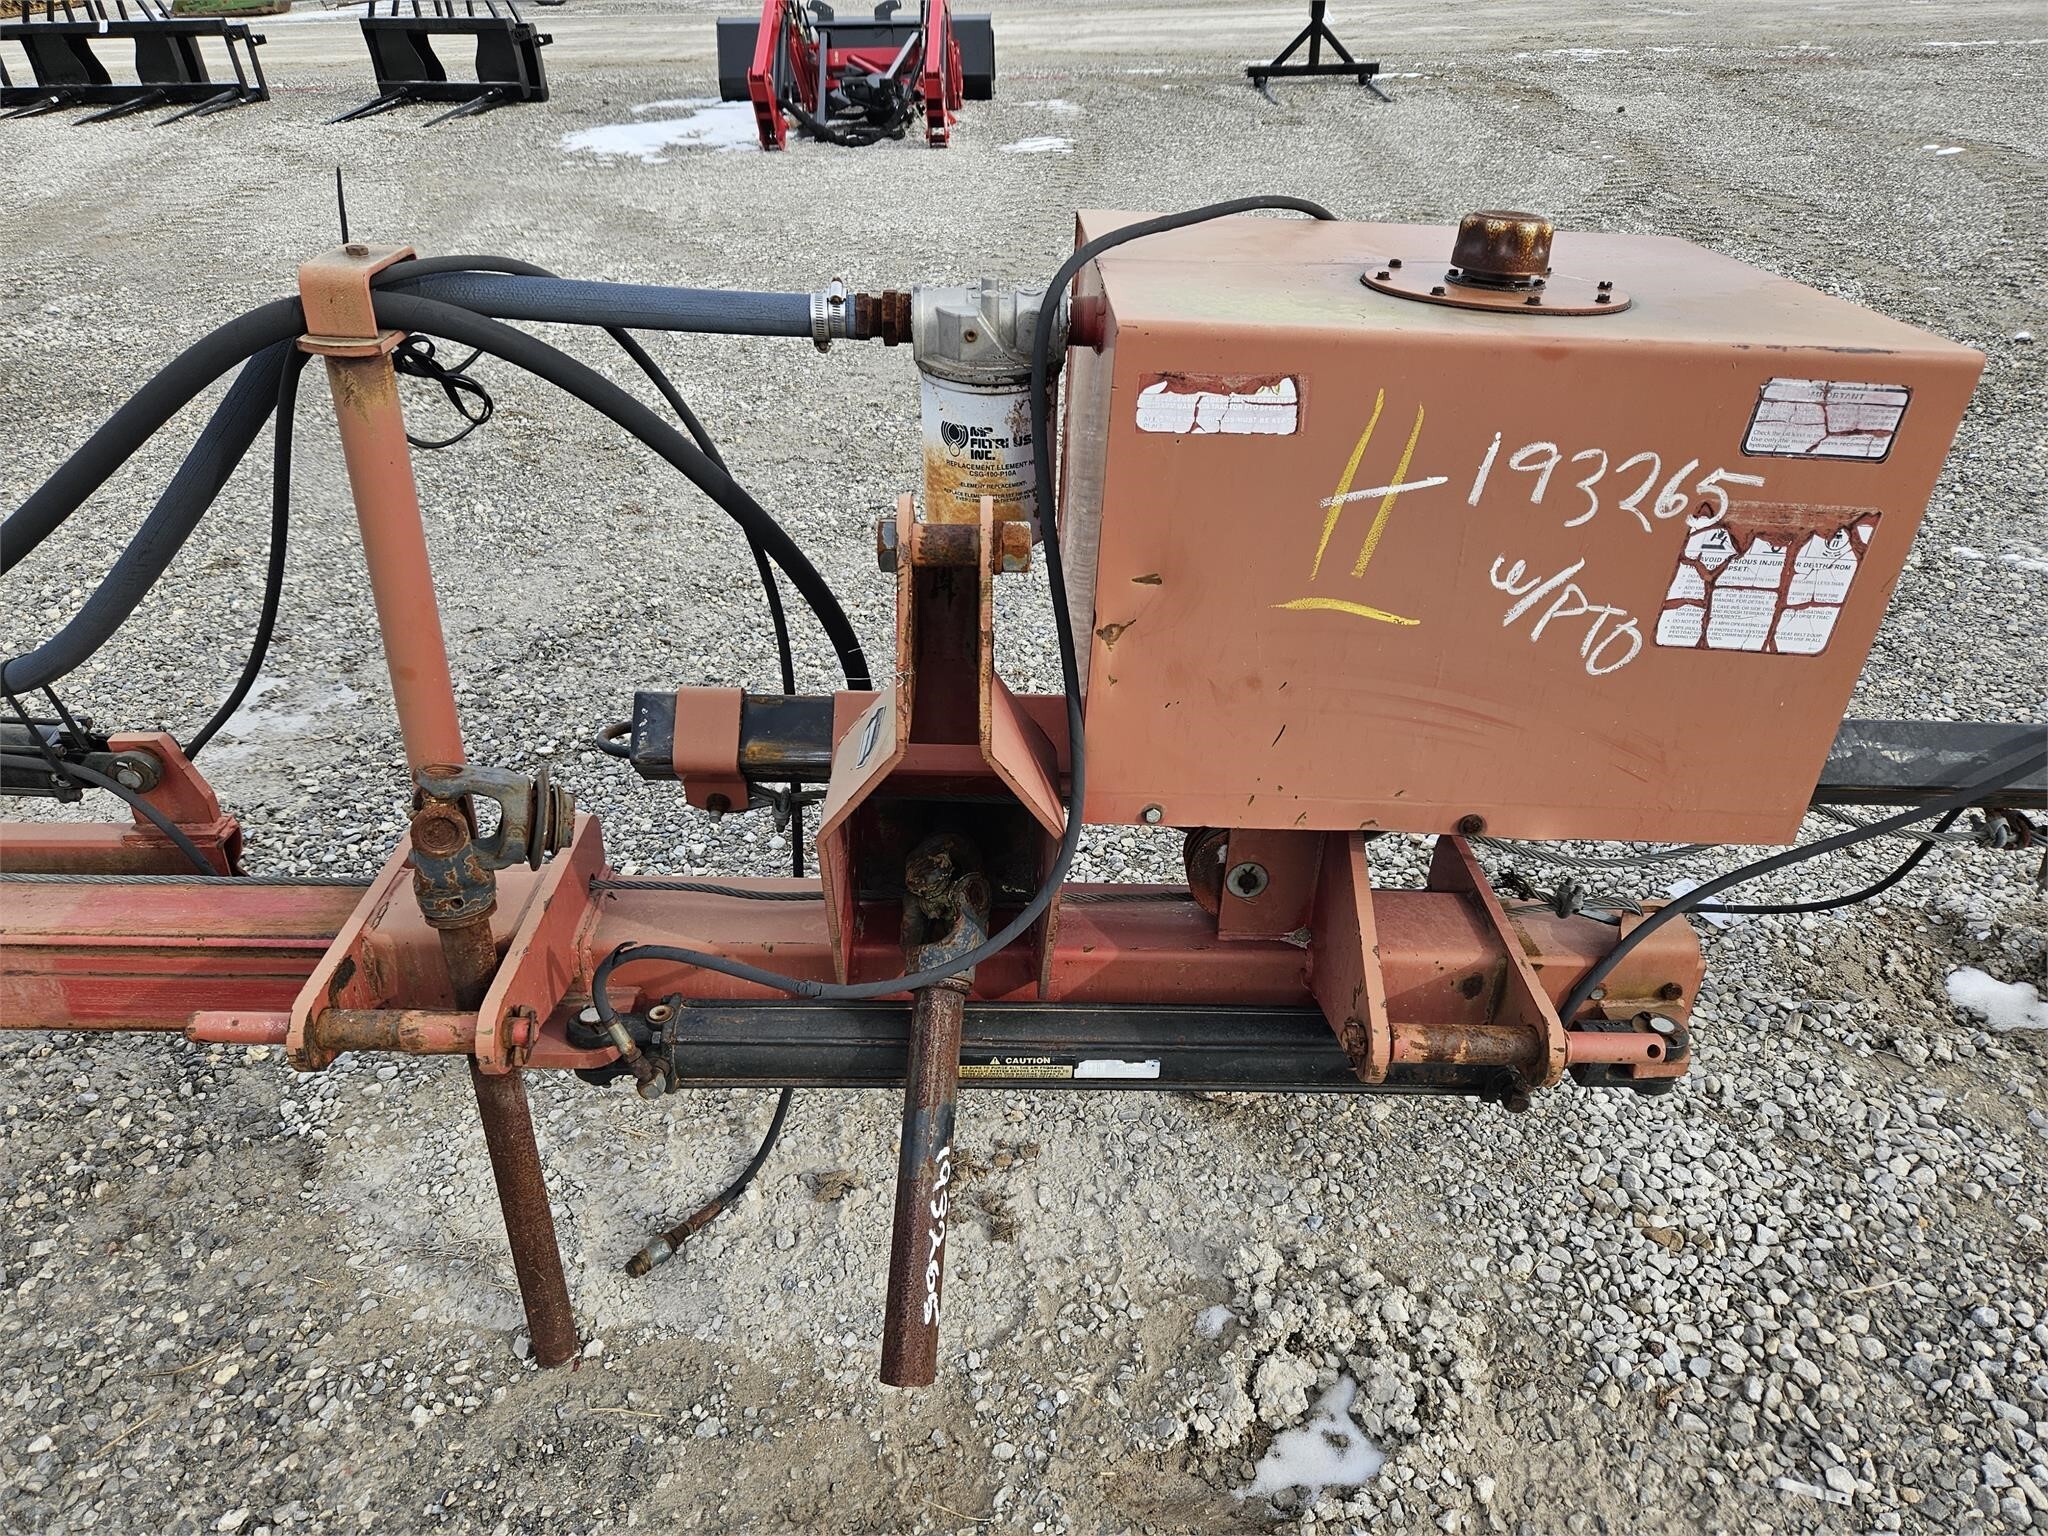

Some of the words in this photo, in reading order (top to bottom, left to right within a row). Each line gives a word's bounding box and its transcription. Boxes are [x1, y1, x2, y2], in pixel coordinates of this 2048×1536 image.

[970, 450, 996, 460] INC.
[946, 459, 995, 471] REPLACEMENT
[996, 460, 1029, 471] ELEMENT
[1311, 387, 1449, 581] H
[1468, 431, 1766, 533] 193265
[1728, 557, 1758, 566] ERIOUS
[1759, 559, 1783, 567] INJUR
[1005, 1057, 1051, 1065] CAUTION
